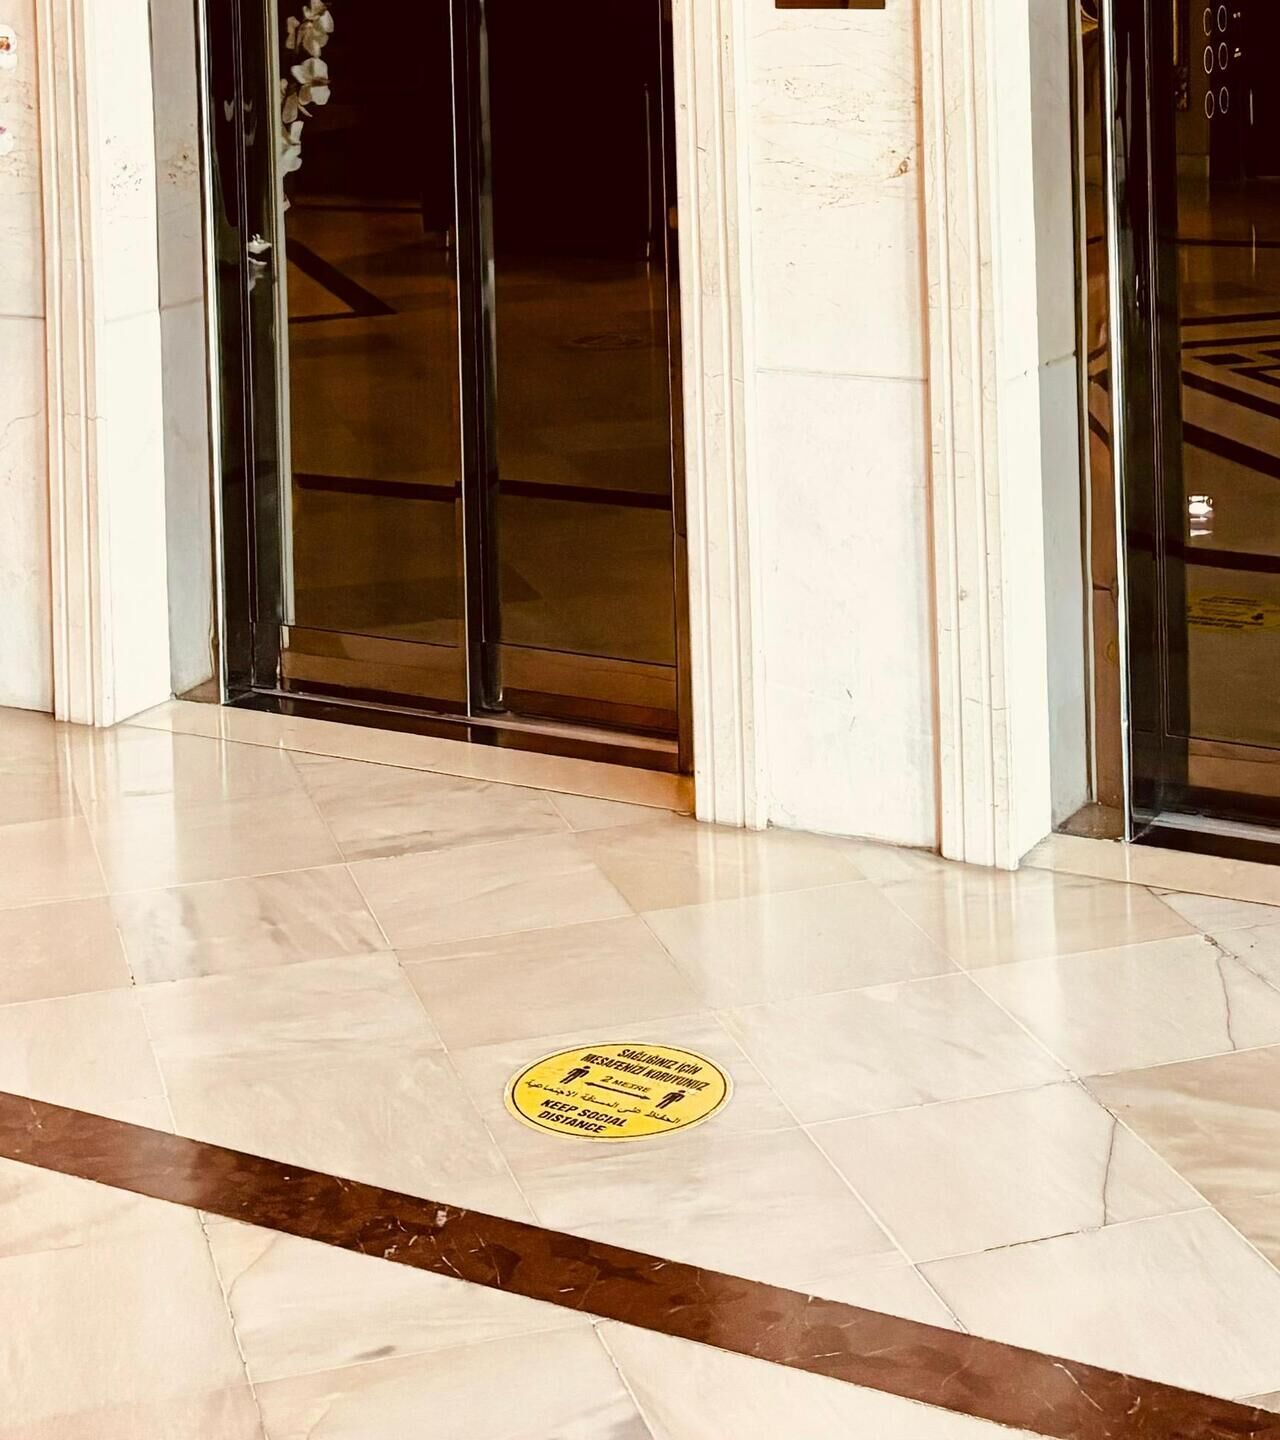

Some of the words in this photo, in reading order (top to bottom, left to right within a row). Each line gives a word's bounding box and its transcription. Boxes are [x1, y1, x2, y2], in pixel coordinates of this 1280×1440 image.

[581, 1054, 648, 1075] MESAFENİZİ
[643, 1067, 710, 1091] KORUYUNUZ
[617, 1049, 678, 1068] SAĞLIĞINIZ
[675, 1062, 702, 1075] İÇİN
[614, 1080, 652, 1092] METRE
[538, 1111, 606, 1133] DISTANCE
[541, 1099, 578, 1113] KEEP
[578, 1110, 628, 1127] SOCIAL
